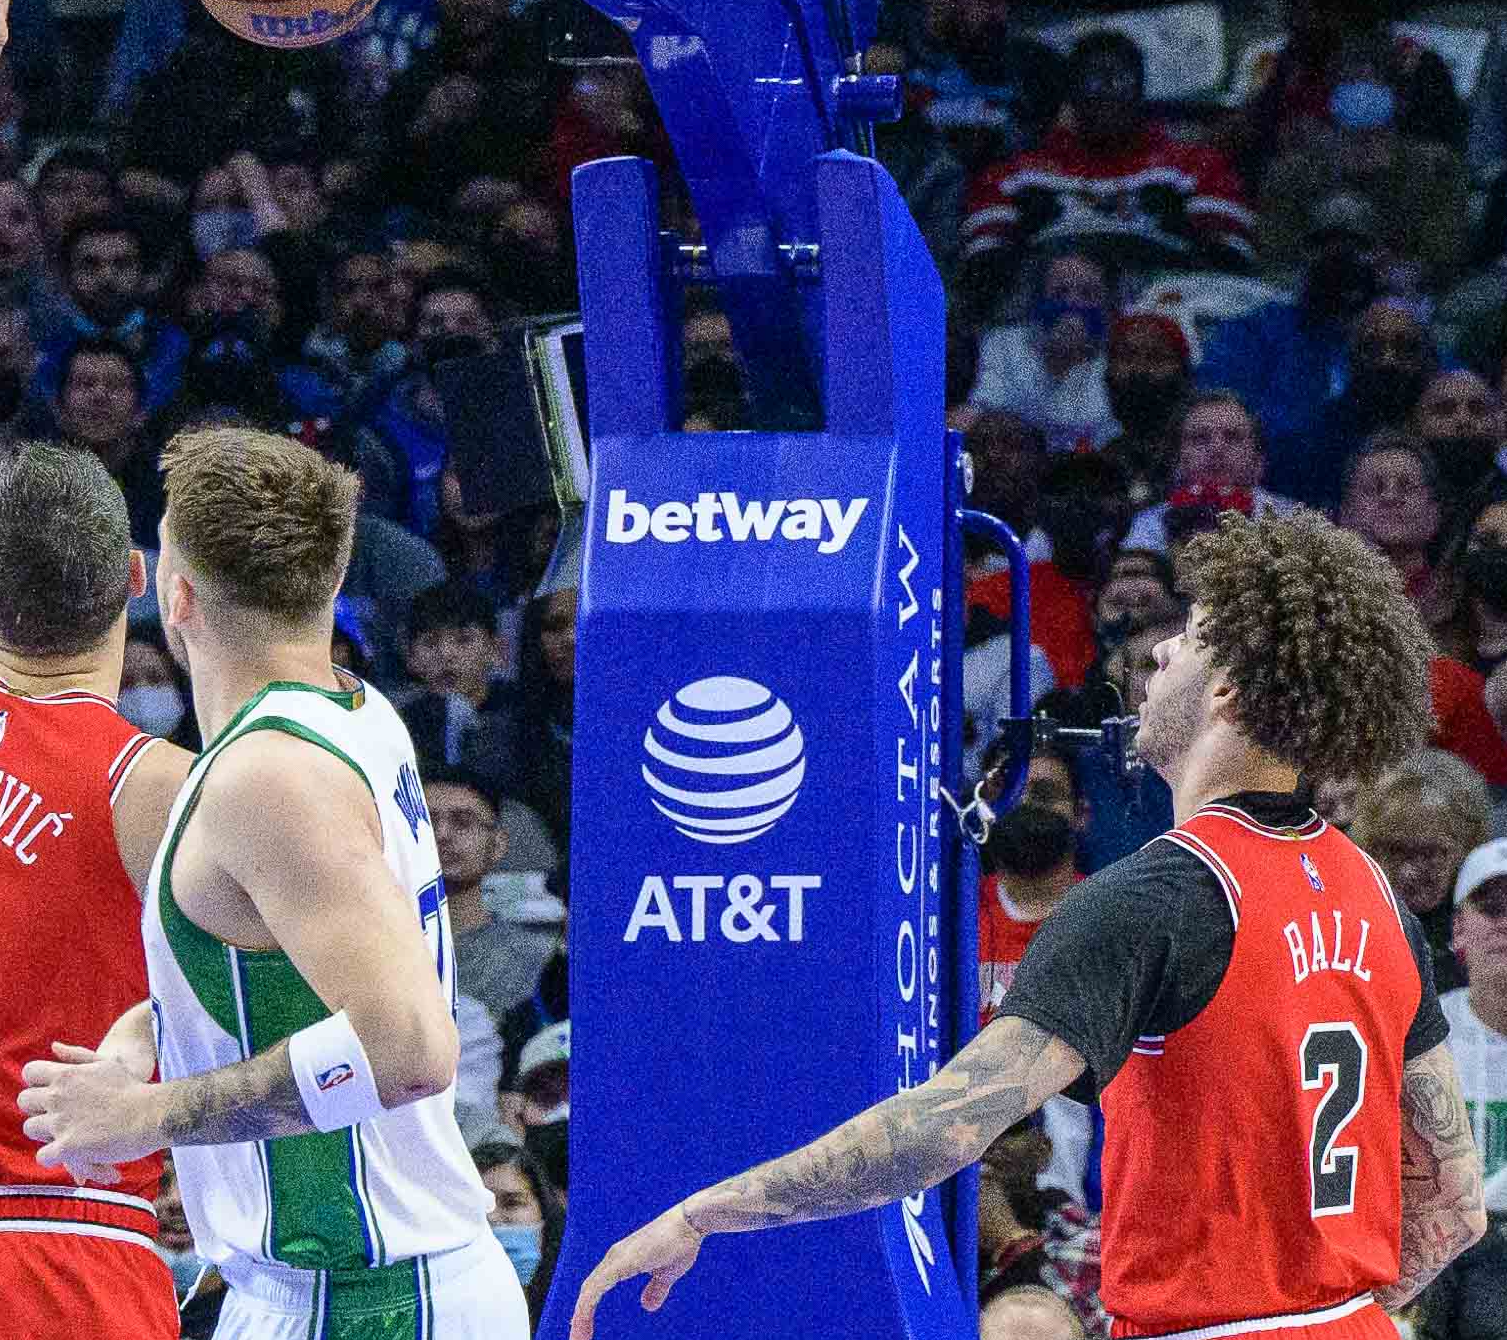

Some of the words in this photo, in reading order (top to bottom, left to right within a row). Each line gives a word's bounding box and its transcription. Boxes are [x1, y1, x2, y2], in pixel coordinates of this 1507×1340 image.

[605, 490, 869, 554] betway
[929, 588, 943, 838] RESORTS
[896, 523, 921, 1097] HOCTAW
[623, 874, 822, 943] AT&T
[1283, 910, 1372, 984] BALL
[1298, 1021, 1368, 1219] 2
